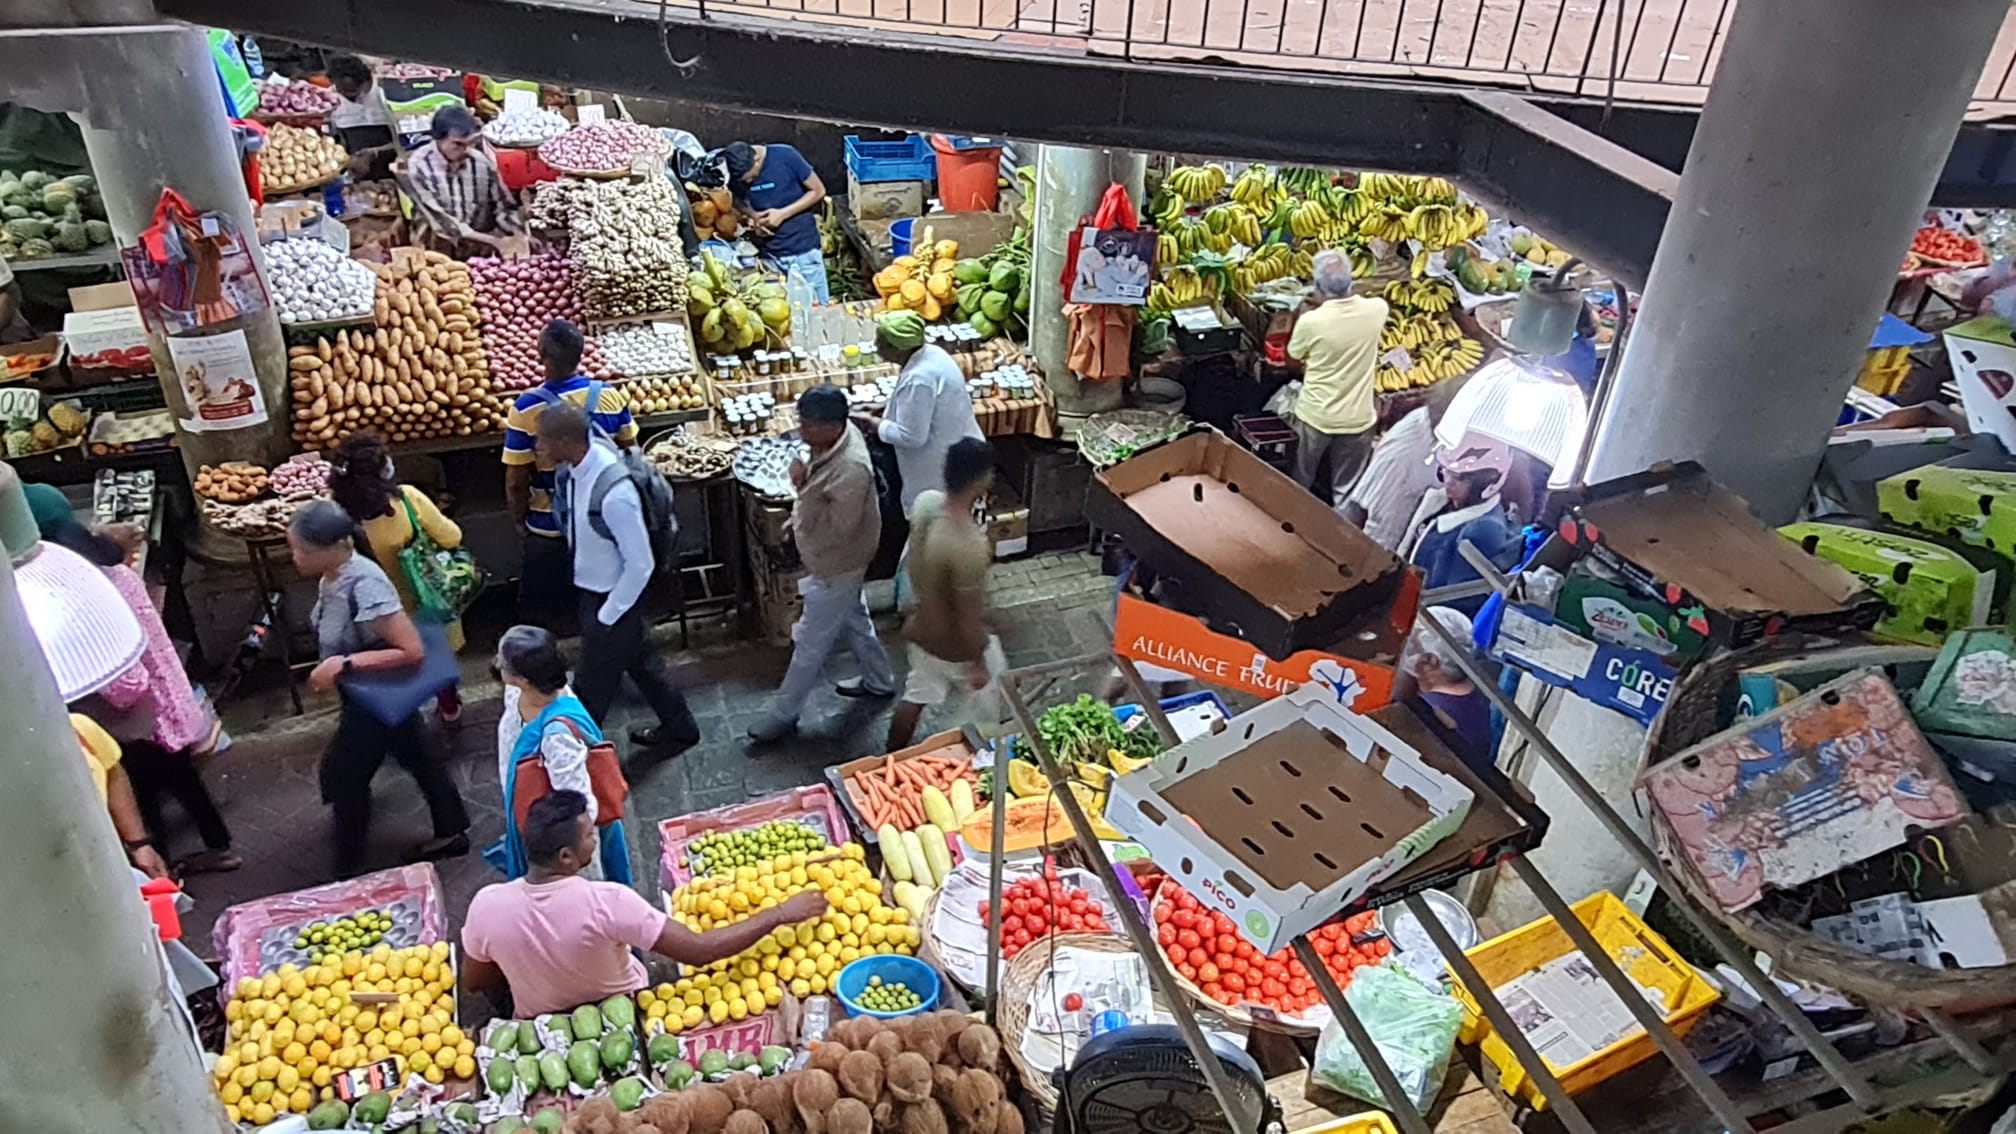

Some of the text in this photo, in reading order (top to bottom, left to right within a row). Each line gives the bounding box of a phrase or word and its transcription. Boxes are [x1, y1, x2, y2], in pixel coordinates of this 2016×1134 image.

[1131, 635, 1300, 698] ALLIANCE FRUI
[1201, 877, 1237, 911] PICO
